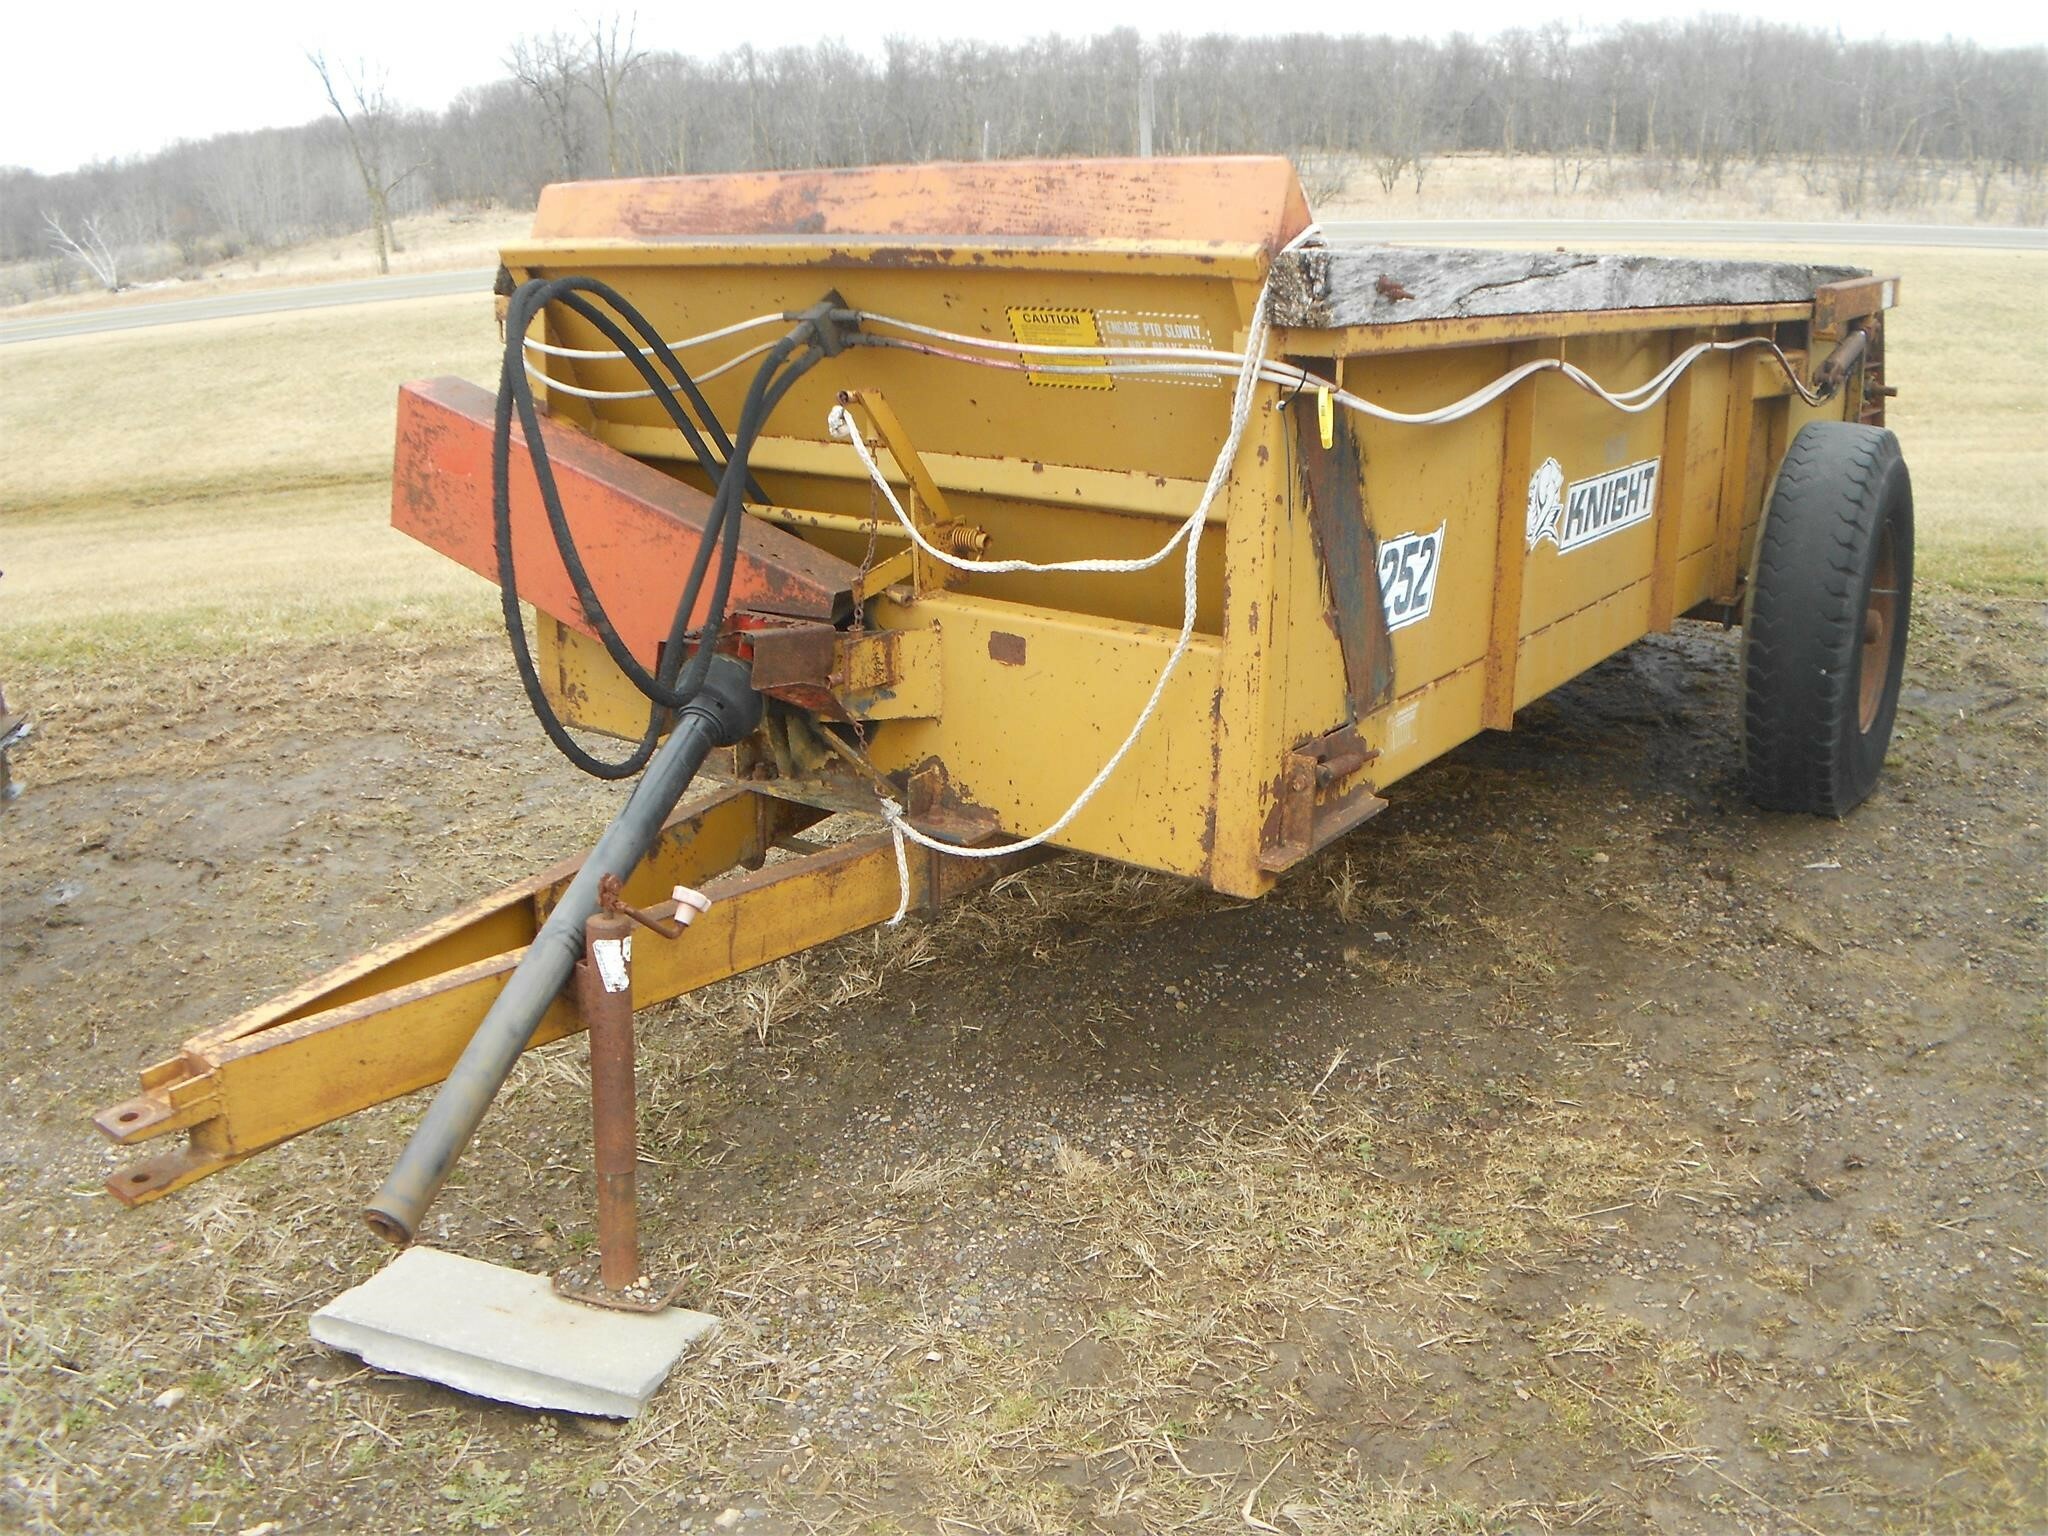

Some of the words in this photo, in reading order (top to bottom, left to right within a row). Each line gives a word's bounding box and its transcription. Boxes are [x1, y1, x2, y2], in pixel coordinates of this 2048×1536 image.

[1022, 312, 1080, 325] CAUTION
[1105, 320, 1140, 336] ENGAGE
[1143, 322, 1162, 337] PTO
[1164, 323, 1206, 340] SLOWLY.
[1564, 466, 1656, 540] KNIGHT
[1382, 536, 1435, 621] 252
